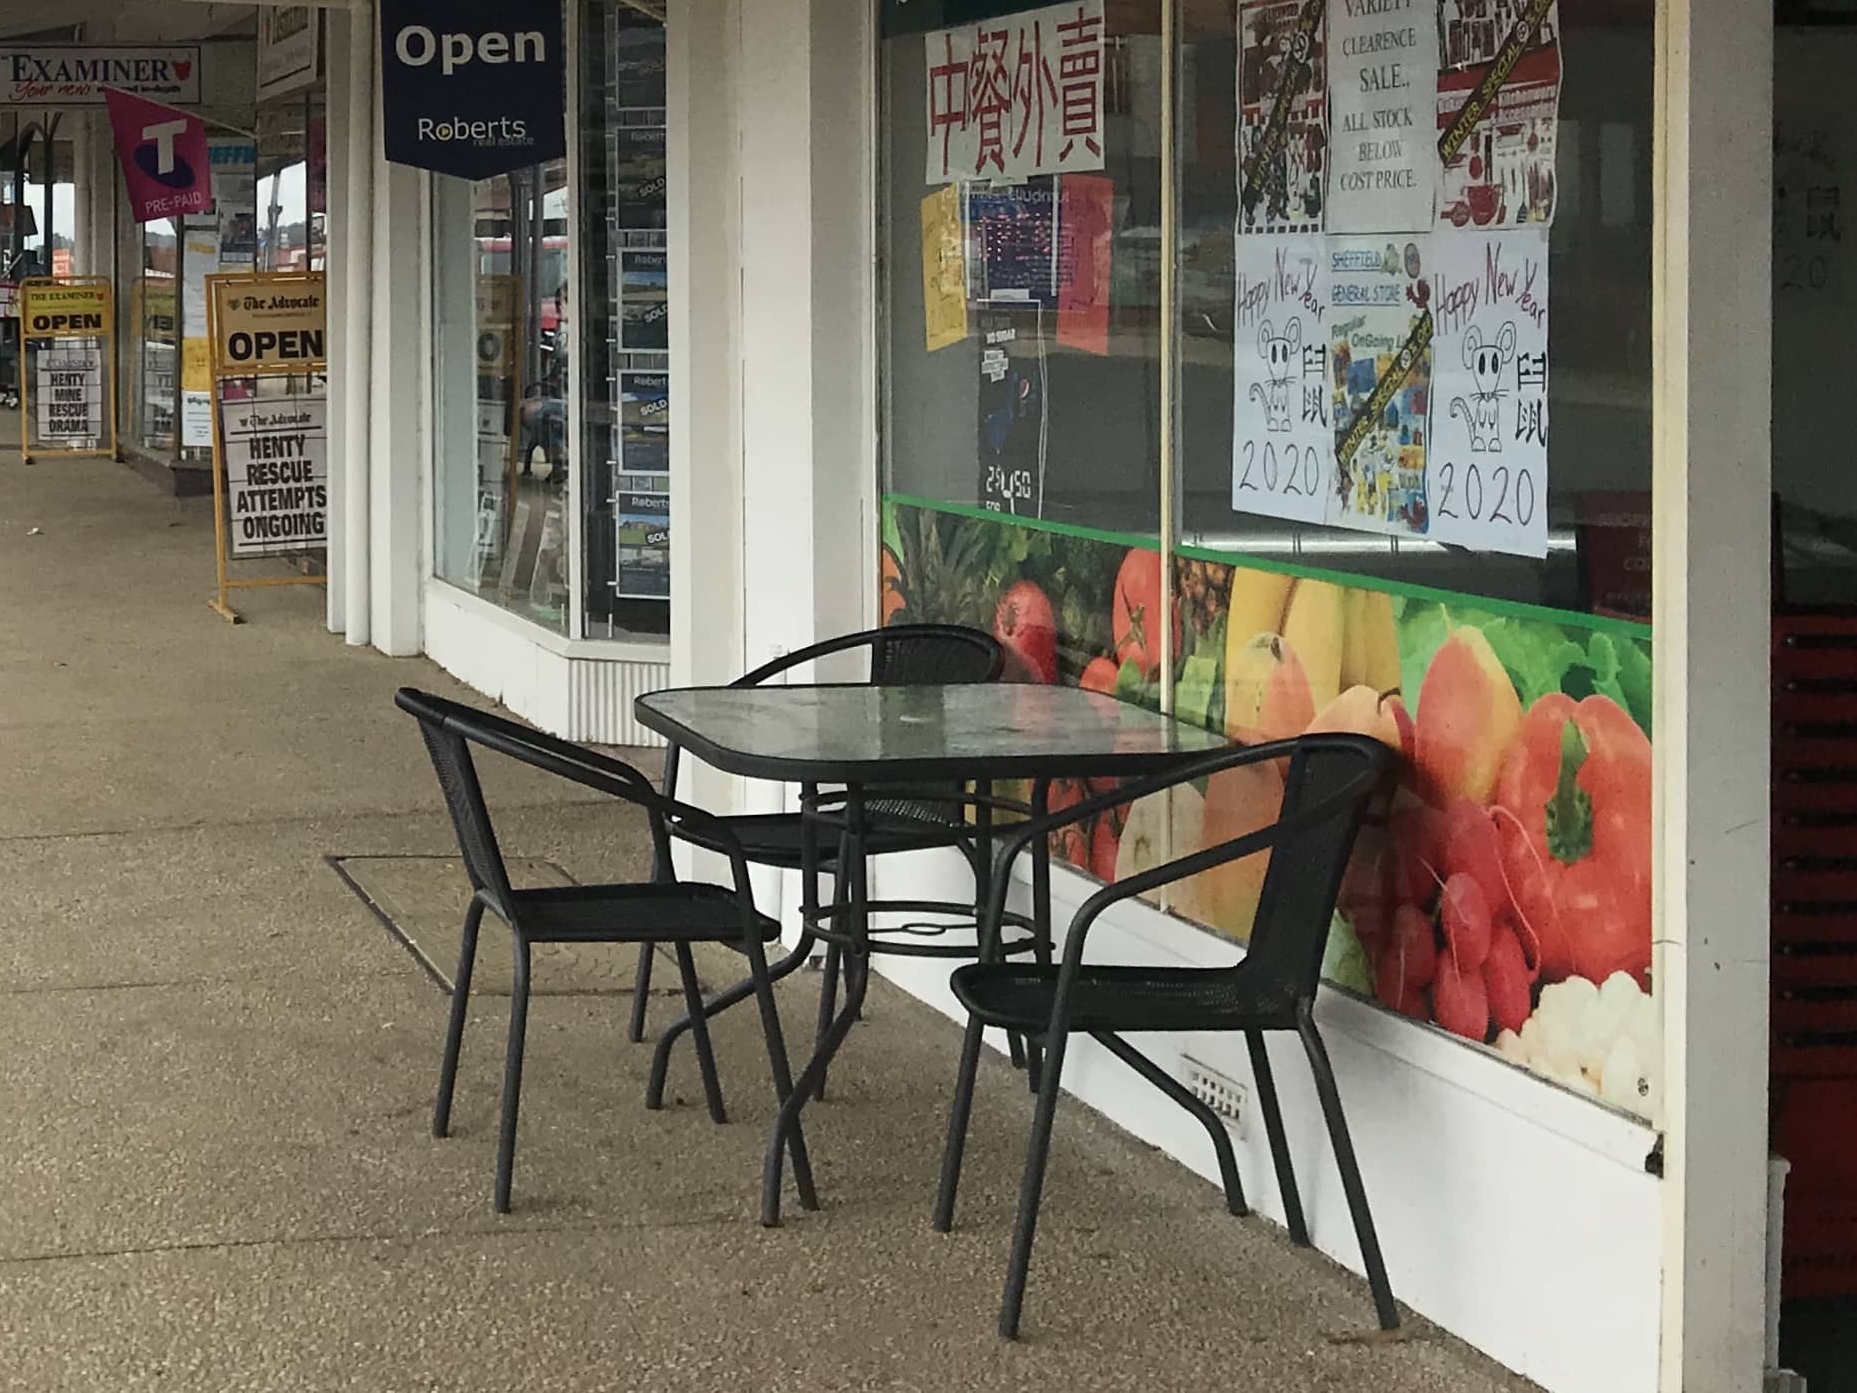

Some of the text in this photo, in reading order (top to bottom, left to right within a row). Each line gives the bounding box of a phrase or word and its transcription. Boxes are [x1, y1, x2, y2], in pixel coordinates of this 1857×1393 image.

[395, 25, 546, 75] Open
[1342, 27, 1416, 57] CLEARENCE
[10, 54, 170, 82] EXAMINER
[929, 7, 1103, 176] 中餐外賣
[1442, 101, 1480, 159] WINTER
[1482, 41, 1522, 101] SPECIAL
[418, 116, 526, 141] Roberts
[1342, 107, 1414, 133] ALL STOCK
[1358, 139, 1404, 161] BELOW
[637, 177, 665, 197] SOLD
[1340, 170, 1373, 192] COST
[145, 190, 203, 215] PRE-PAID
[1330, 249, 1383, 269] SHEFFIELD
[49, 291, 96, 301] EXAMINER
[1236, 246, 1326, 329] Happy New Year
[1330, 283, 1401, 303] GENERAL STORE
[1433, 241, 1547, 337] Happy New Year
[243, 294, 320, 311] The Advocate
[32, 313, 102, 331] OPEN
[228, 329, 324, 361] OPEN
[49, 373, 86, 387] HENTY
[54, 388, 83, 402] MINE
[48, 403, 89, 418] RESCUE
[249, 413, 269, 428] The
[639, 399, 668, 417] SOLD
[48, 419, 89, 433] DRAMA
[248, 434, 307, 460] HENTY
[246, 459, 314, 487] RESCUE
[1238, 439, 1320, 497] 2020
[236, 484, 327, 514] ATTEMPTS
[1437, 461, 1536, 527] 2020
[242, 510, 325, 541] ONGOING
